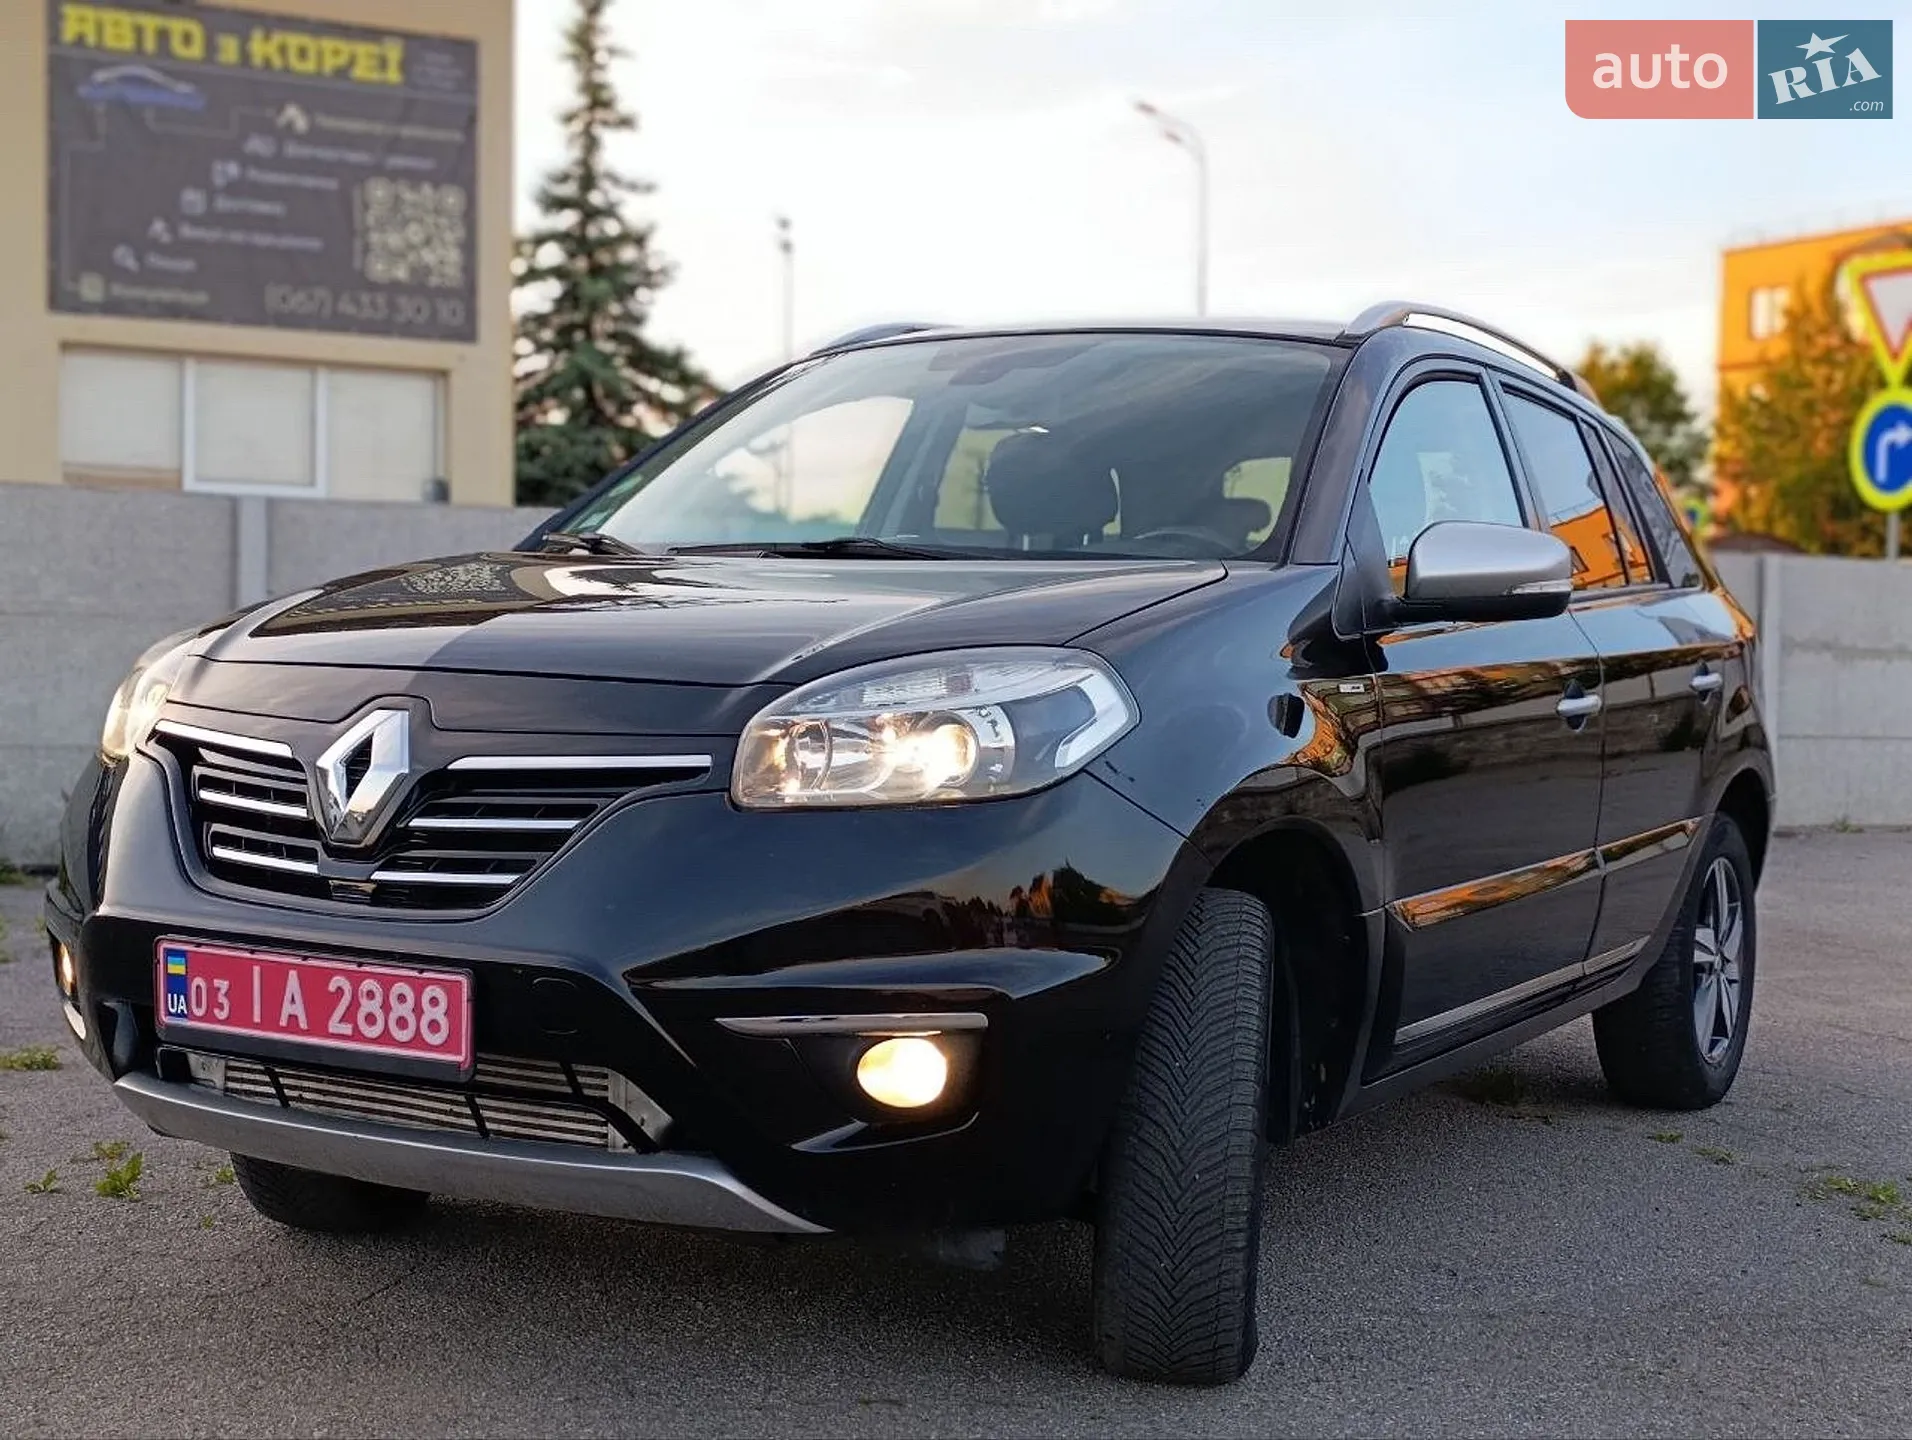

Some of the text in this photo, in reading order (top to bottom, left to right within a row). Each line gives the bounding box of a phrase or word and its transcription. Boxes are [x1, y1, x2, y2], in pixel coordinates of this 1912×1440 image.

[60, 5, 204, 60] АВТО
[247, 26, 405, 85] КОРЕЇ
[265, 283, 333, 319] (067)
[338, 288, 388, 321] 433
[167, 993, 188, 1015] UA
[191, 976, 231, 1021] 03
[327, 975, 450, 1046] 2888
